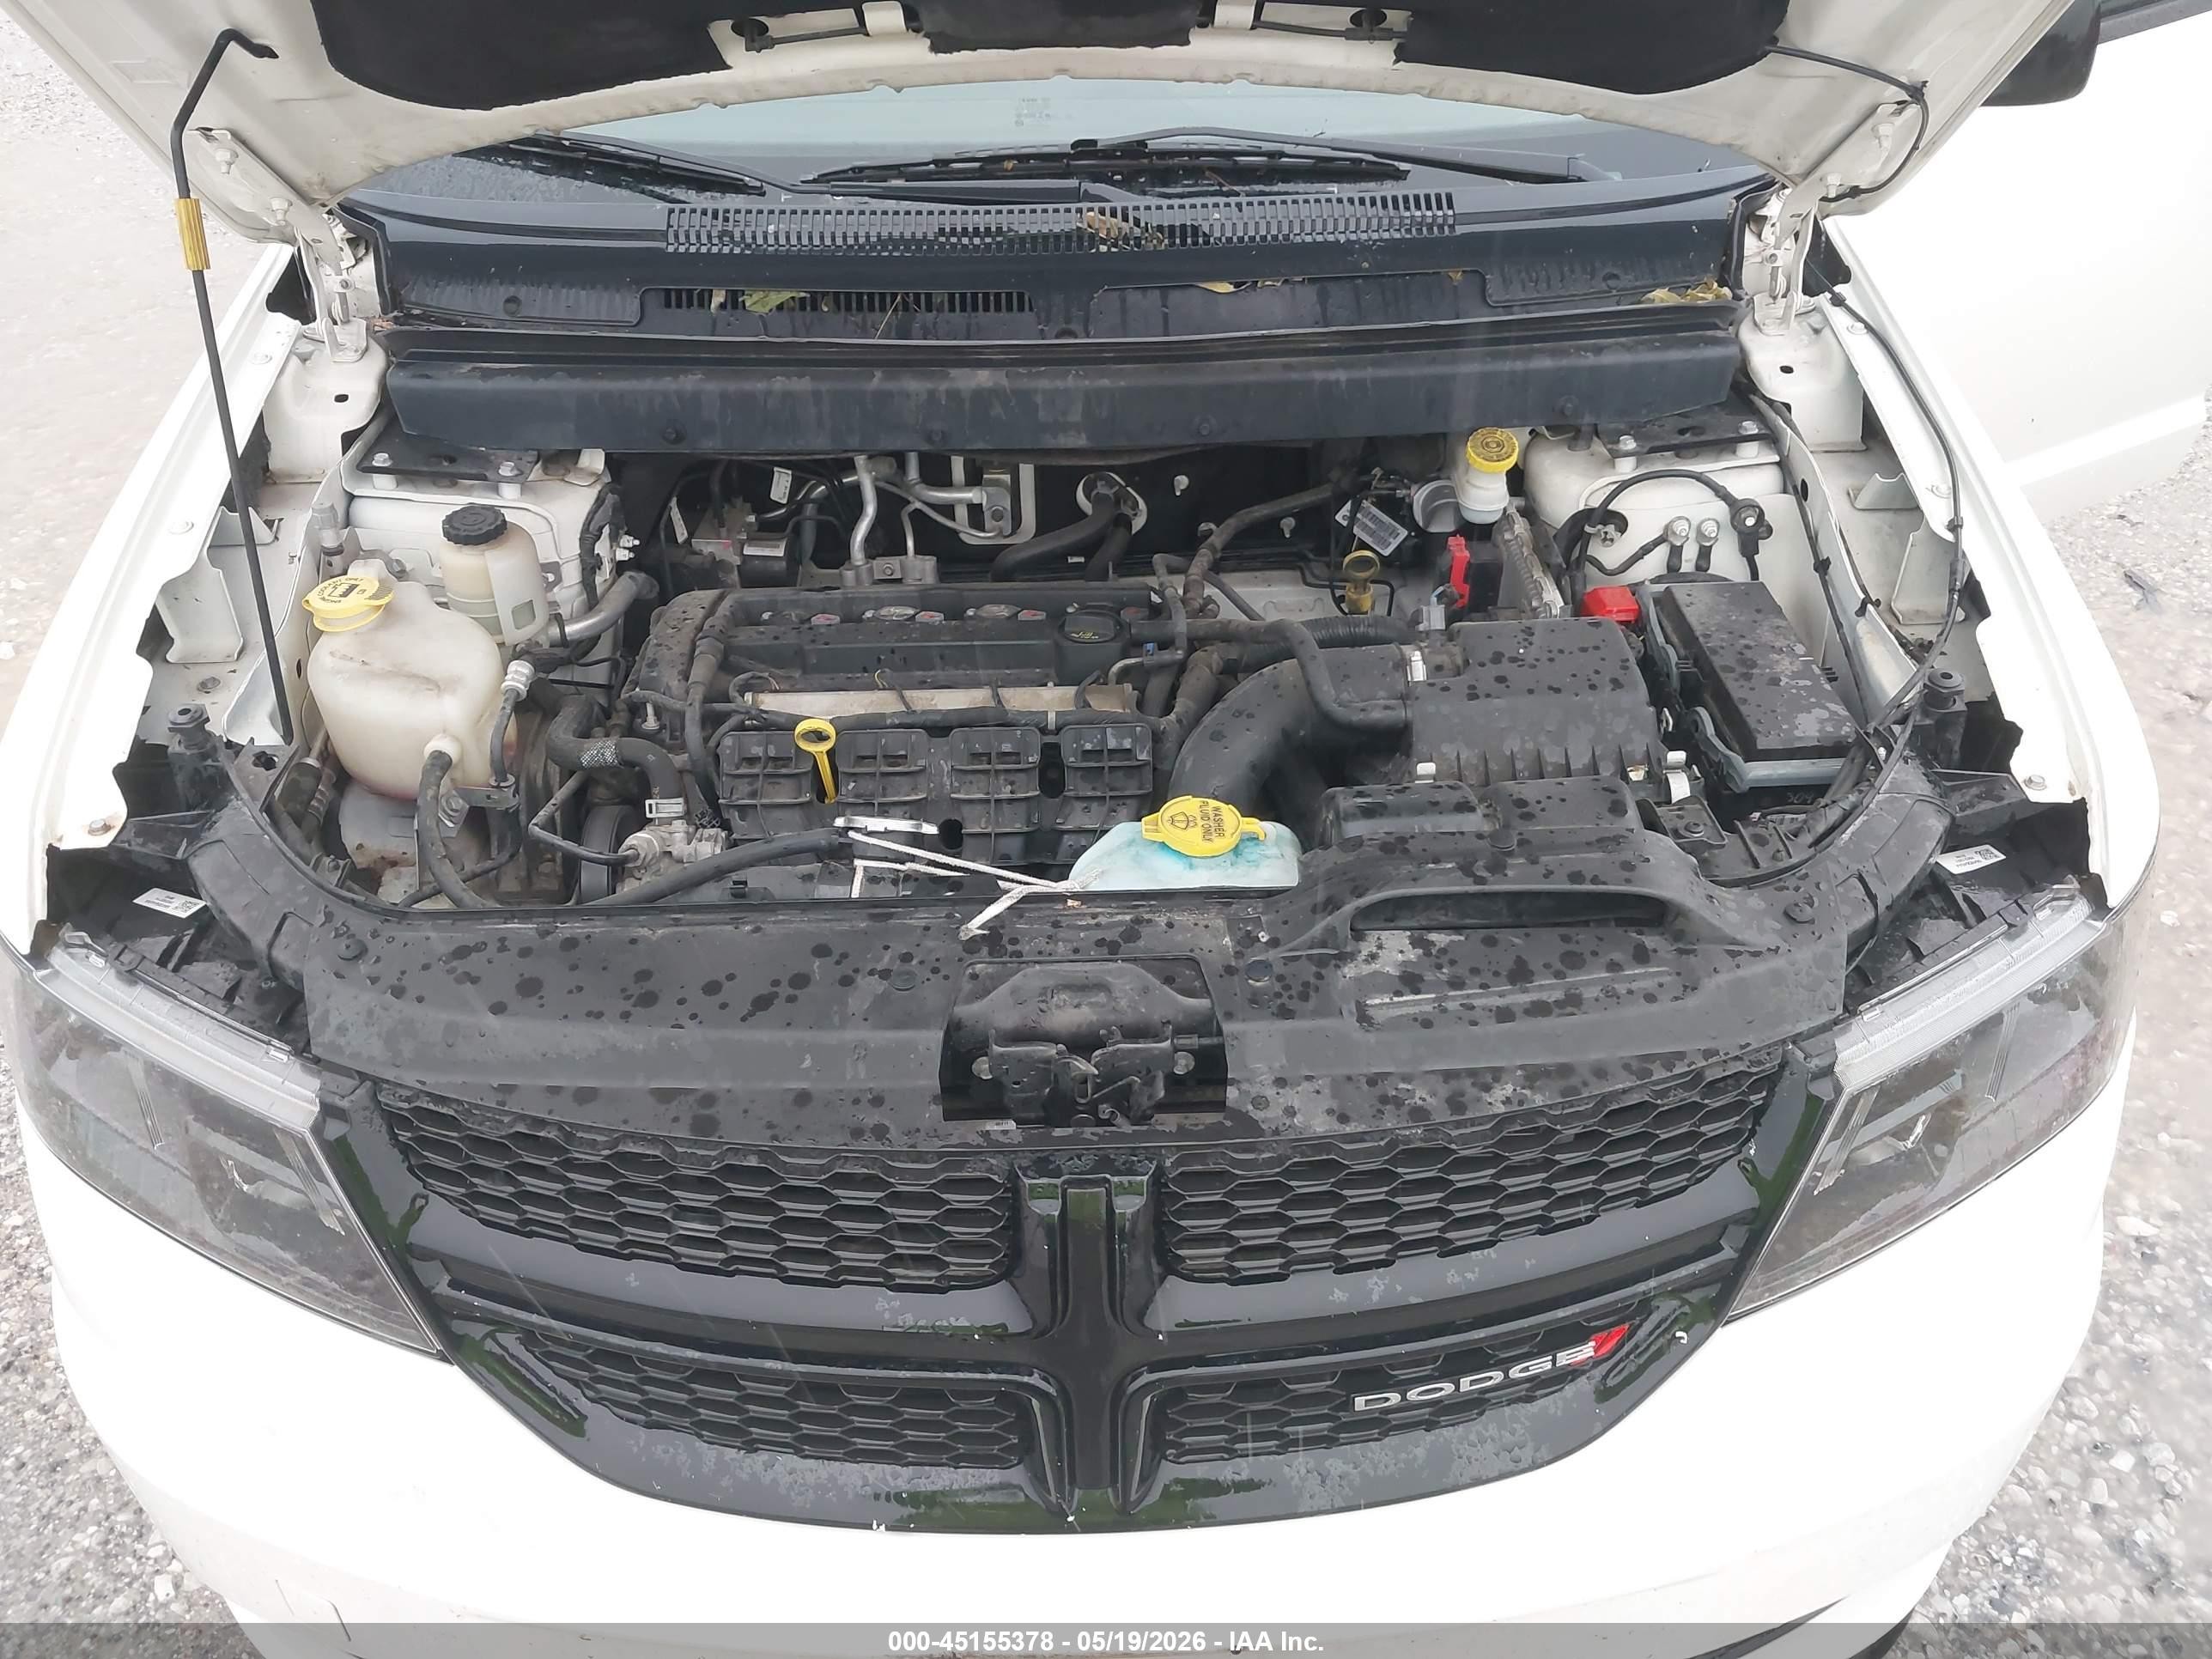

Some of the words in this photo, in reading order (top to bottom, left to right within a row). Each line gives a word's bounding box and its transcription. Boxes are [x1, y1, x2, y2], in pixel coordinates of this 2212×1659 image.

[317, 579, 342, 596] COOLANT
[1200, 800, 1210, 821] FLUID
[1212, 805, 1225, 837] WASHER
[1202, 823, 1213, 842] ONLY
[1352, 1340, 1596, 1412] DODGE
